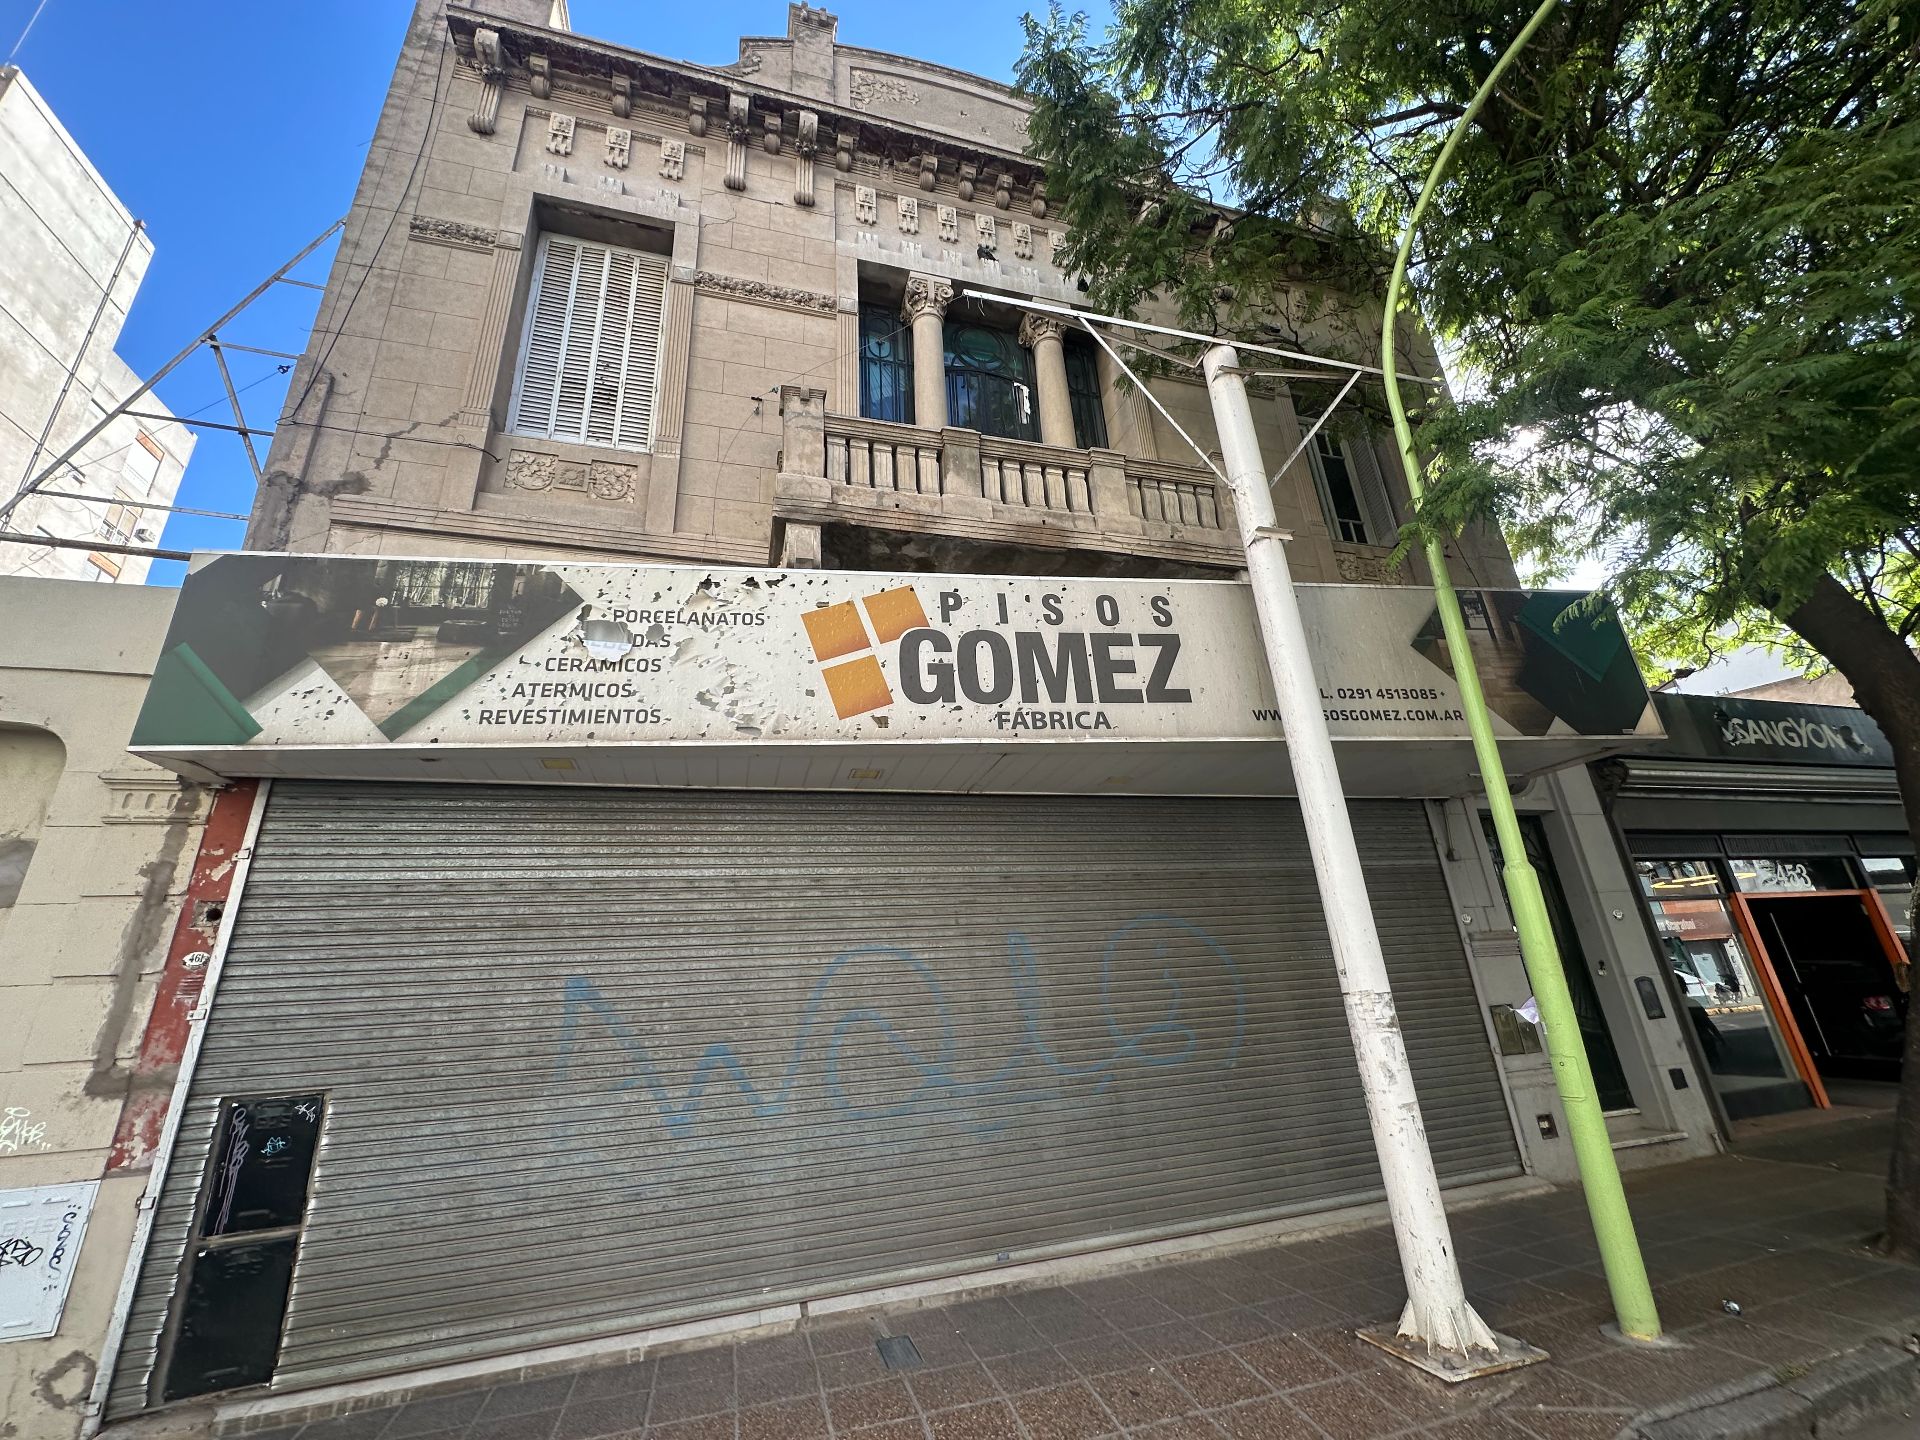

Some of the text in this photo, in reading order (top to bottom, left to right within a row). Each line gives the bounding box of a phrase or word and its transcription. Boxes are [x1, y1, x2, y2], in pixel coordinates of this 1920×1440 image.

[613, 609, 765, 626] PORCELANATOS
[939, 591, 1173, 627] PISOS
[545, 657, 662, 673] CERAMICOS
[899, 628, 1193, 705] GOMEZ
[511, 682, 633, 698] ATERMICOS
[1337, 688, 1373, 700] 0291
[1376, 688, 1438, 700] 4513085
[478, 708, 661, 725] REVESTIMIENTOS
[998, 710, 1112, 731] FÁBRICA
